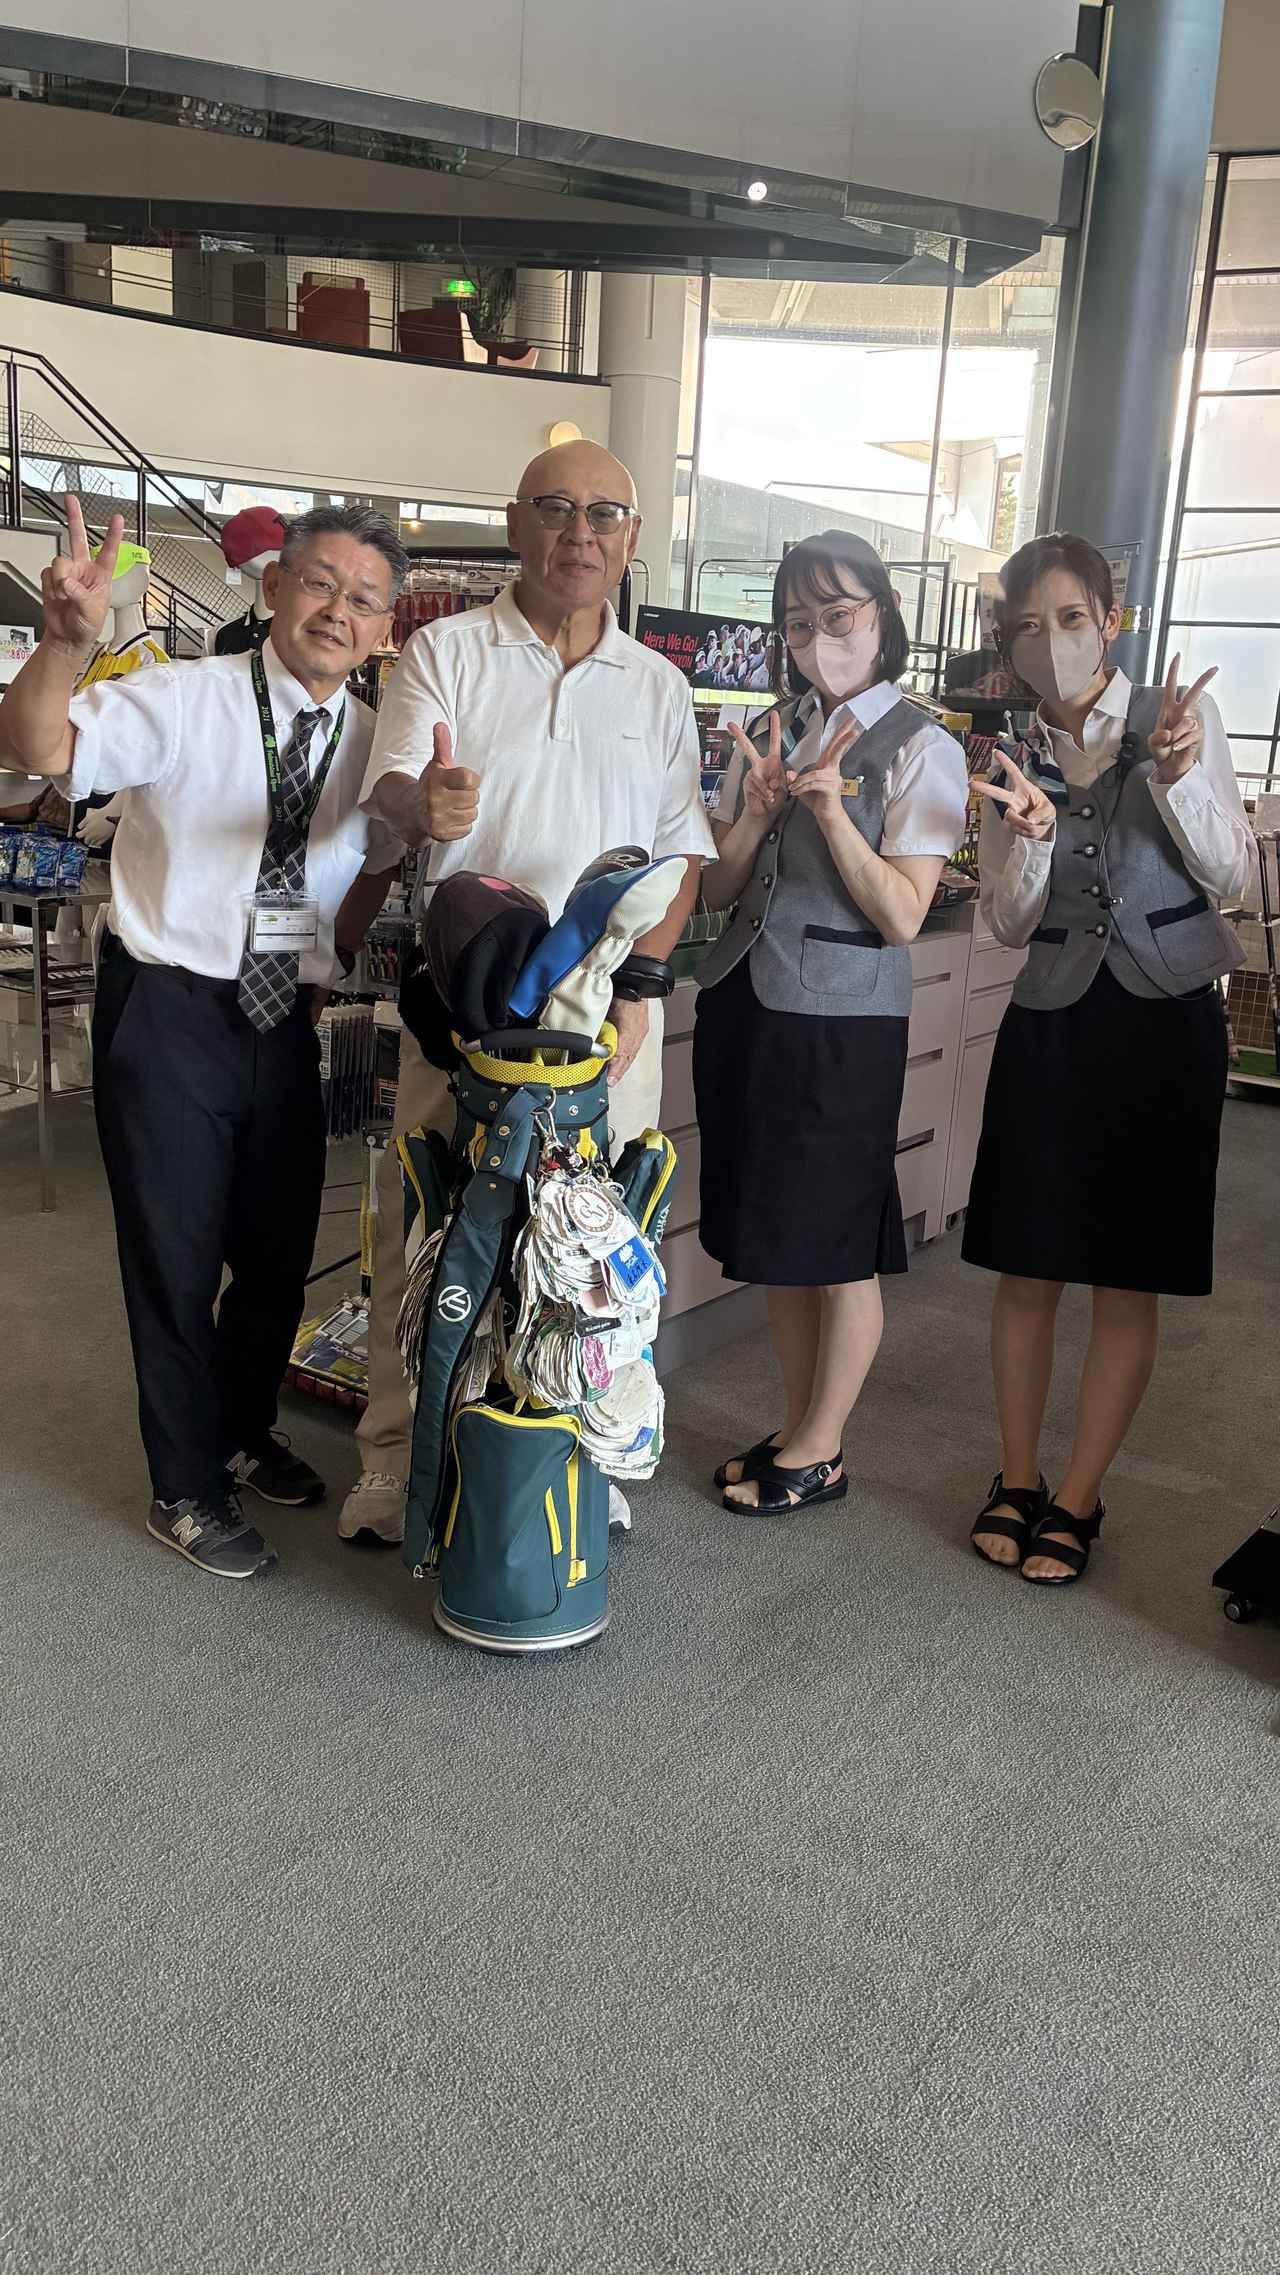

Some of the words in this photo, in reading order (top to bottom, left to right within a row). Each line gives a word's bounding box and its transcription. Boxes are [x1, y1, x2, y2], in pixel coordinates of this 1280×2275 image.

[643, 630, 666, 649] Here
[667, 633, 682, 650] We
[682, 635, 699, 652] Go!
[262, 705, 271, 721] 2021
[225, 1450, 260, 1480] N
[171, 1514, 203, 1548] N
